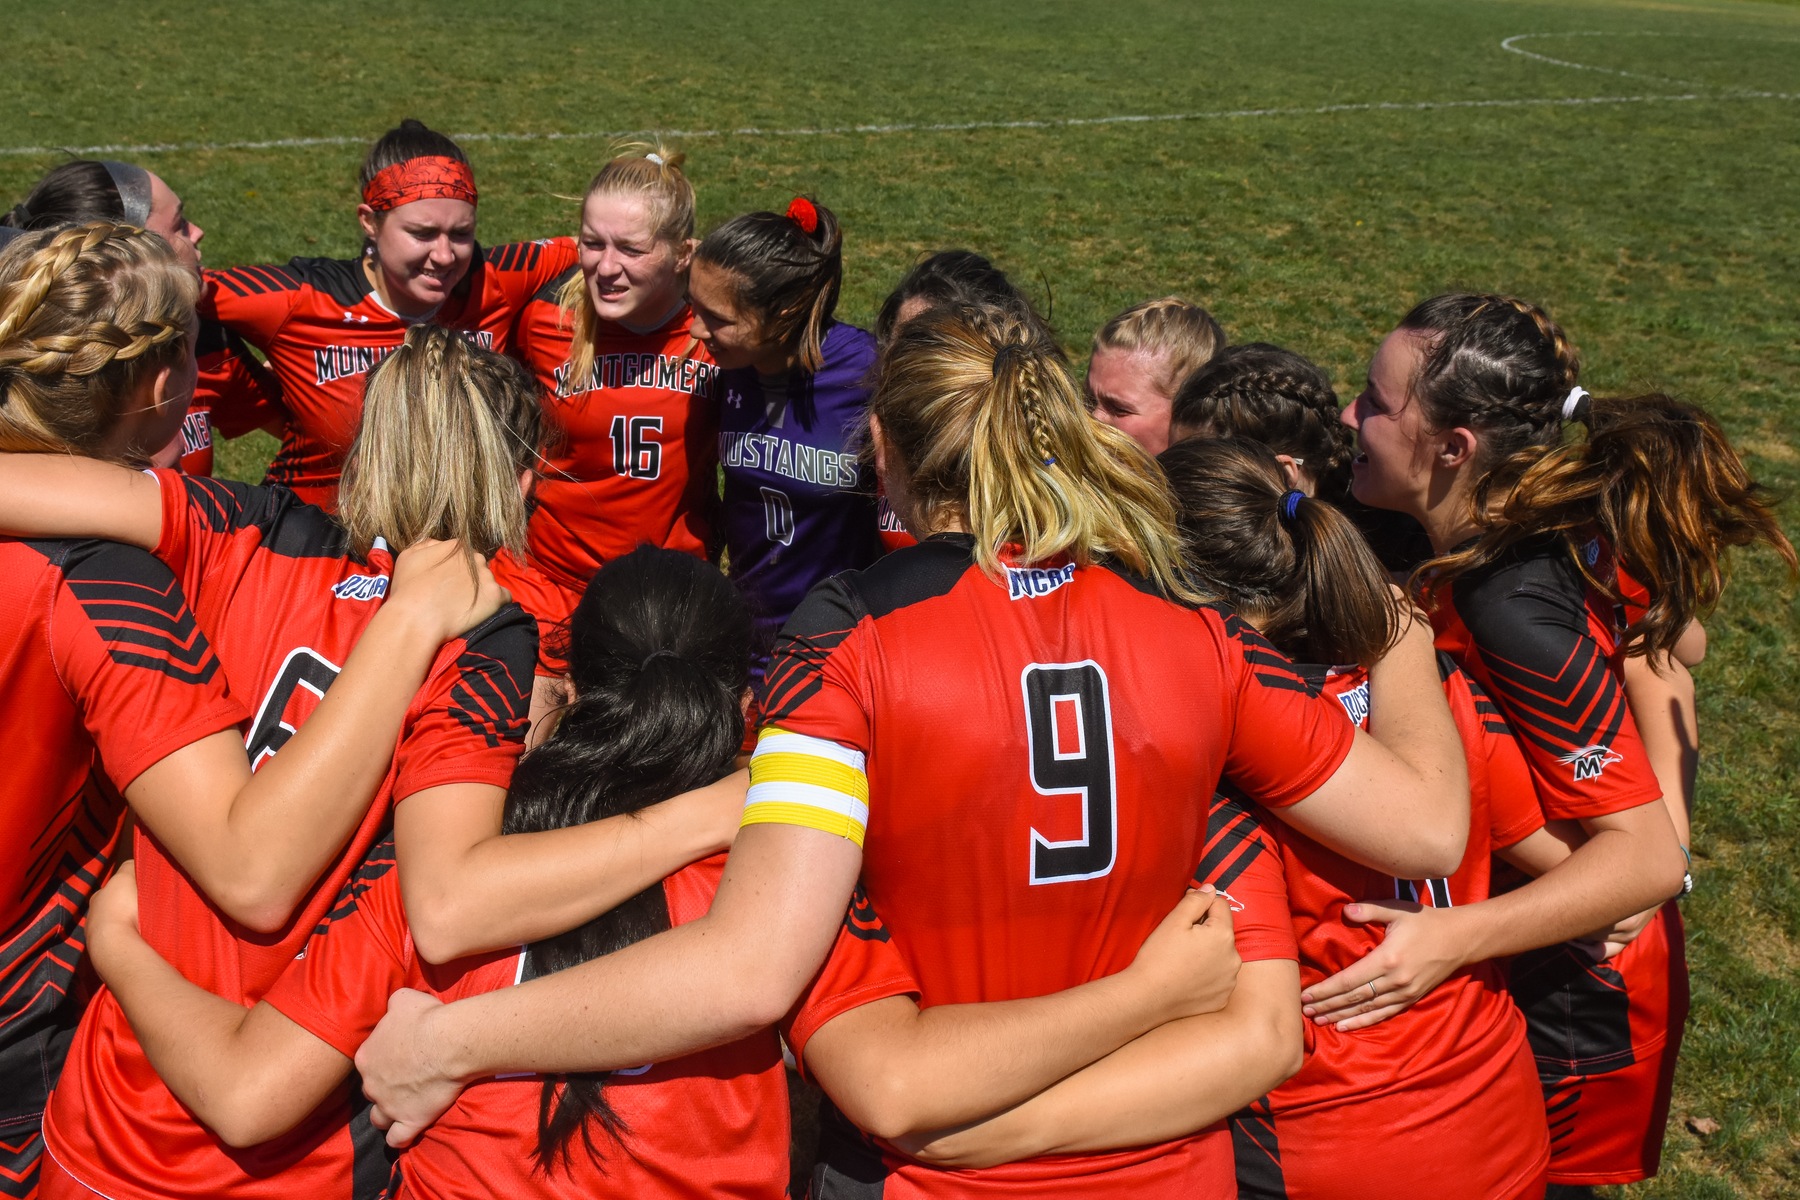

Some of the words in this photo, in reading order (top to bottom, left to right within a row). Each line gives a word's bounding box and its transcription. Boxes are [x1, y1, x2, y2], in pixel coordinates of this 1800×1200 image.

[609, 415, 663, 481] 16
[760, 486, 795, 546] 0
[1021, 658, 1117, 886] 9
